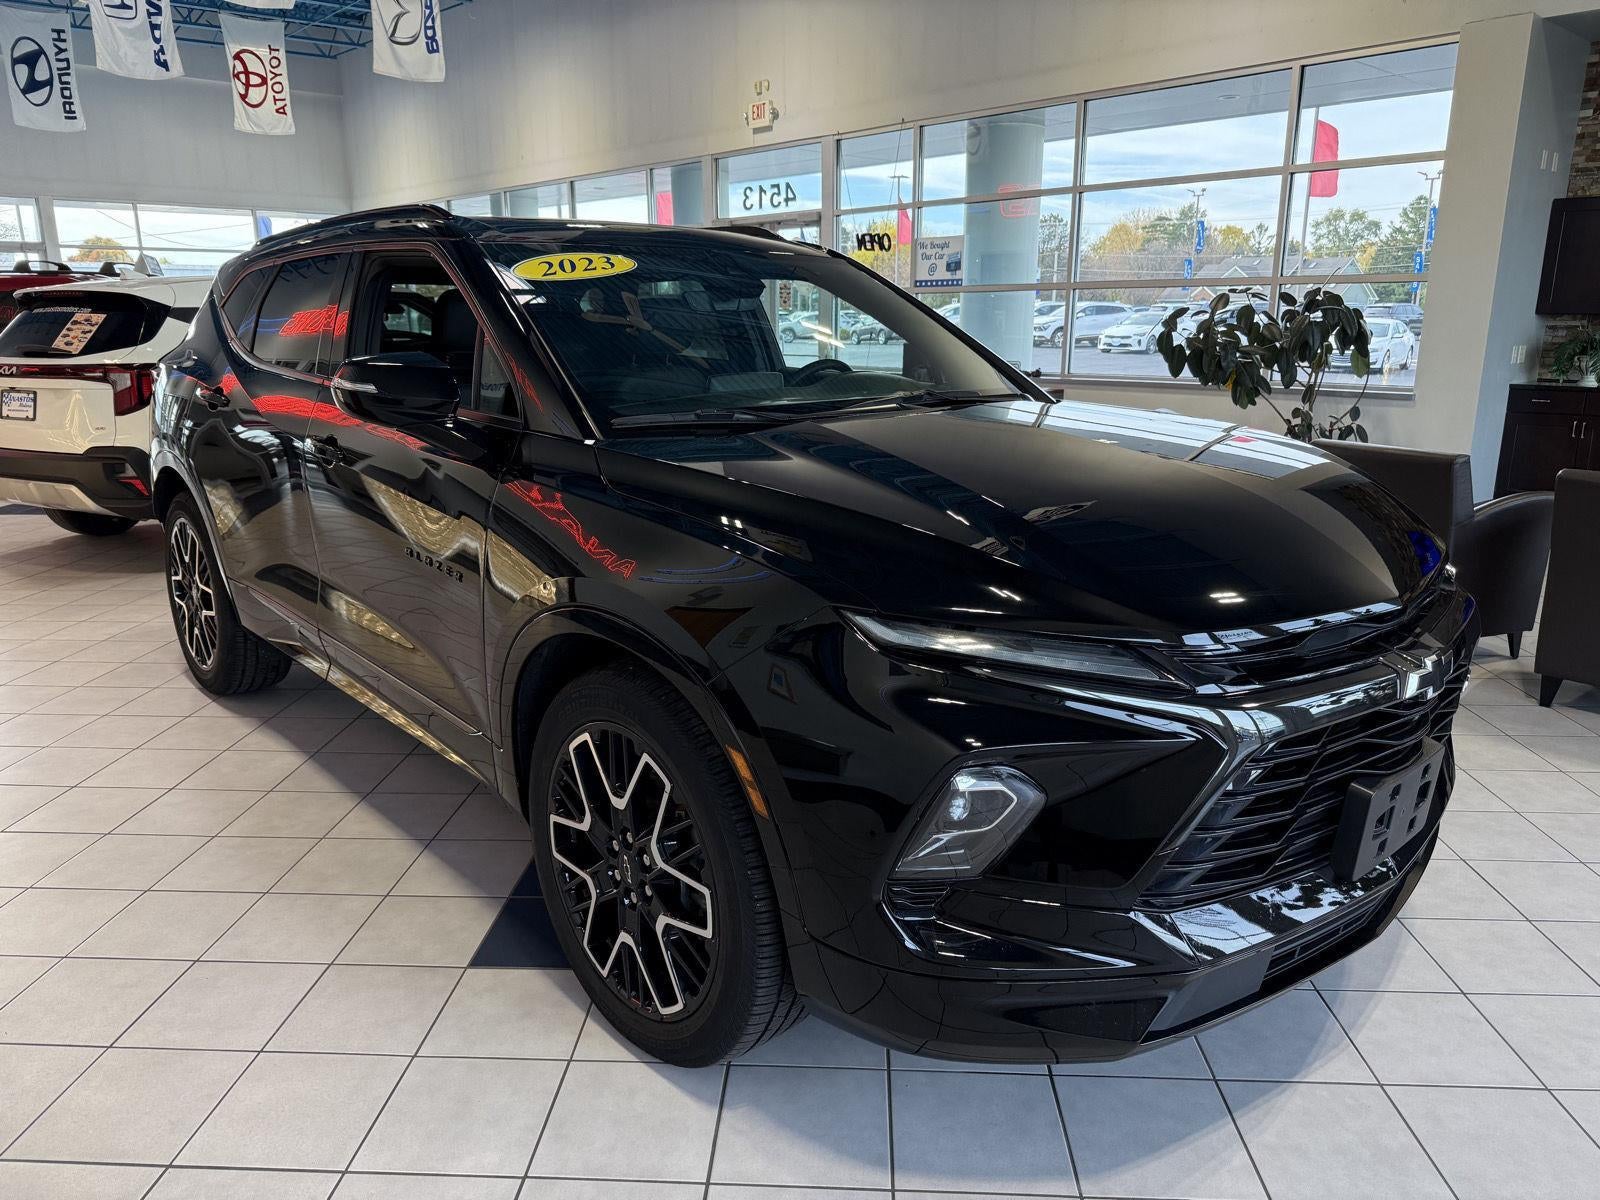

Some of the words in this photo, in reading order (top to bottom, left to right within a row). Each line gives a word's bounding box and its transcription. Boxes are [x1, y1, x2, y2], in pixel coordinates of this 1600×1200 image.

[752, 102, 766, 121] EXIT
[930, 240, 951, 251] Bought
[921, 252, 933, 261] Our
[934, 251, 946, 260] Car
[537, 256, 616, 277] 2023
[405, 546, 464, 583] BLAZER
